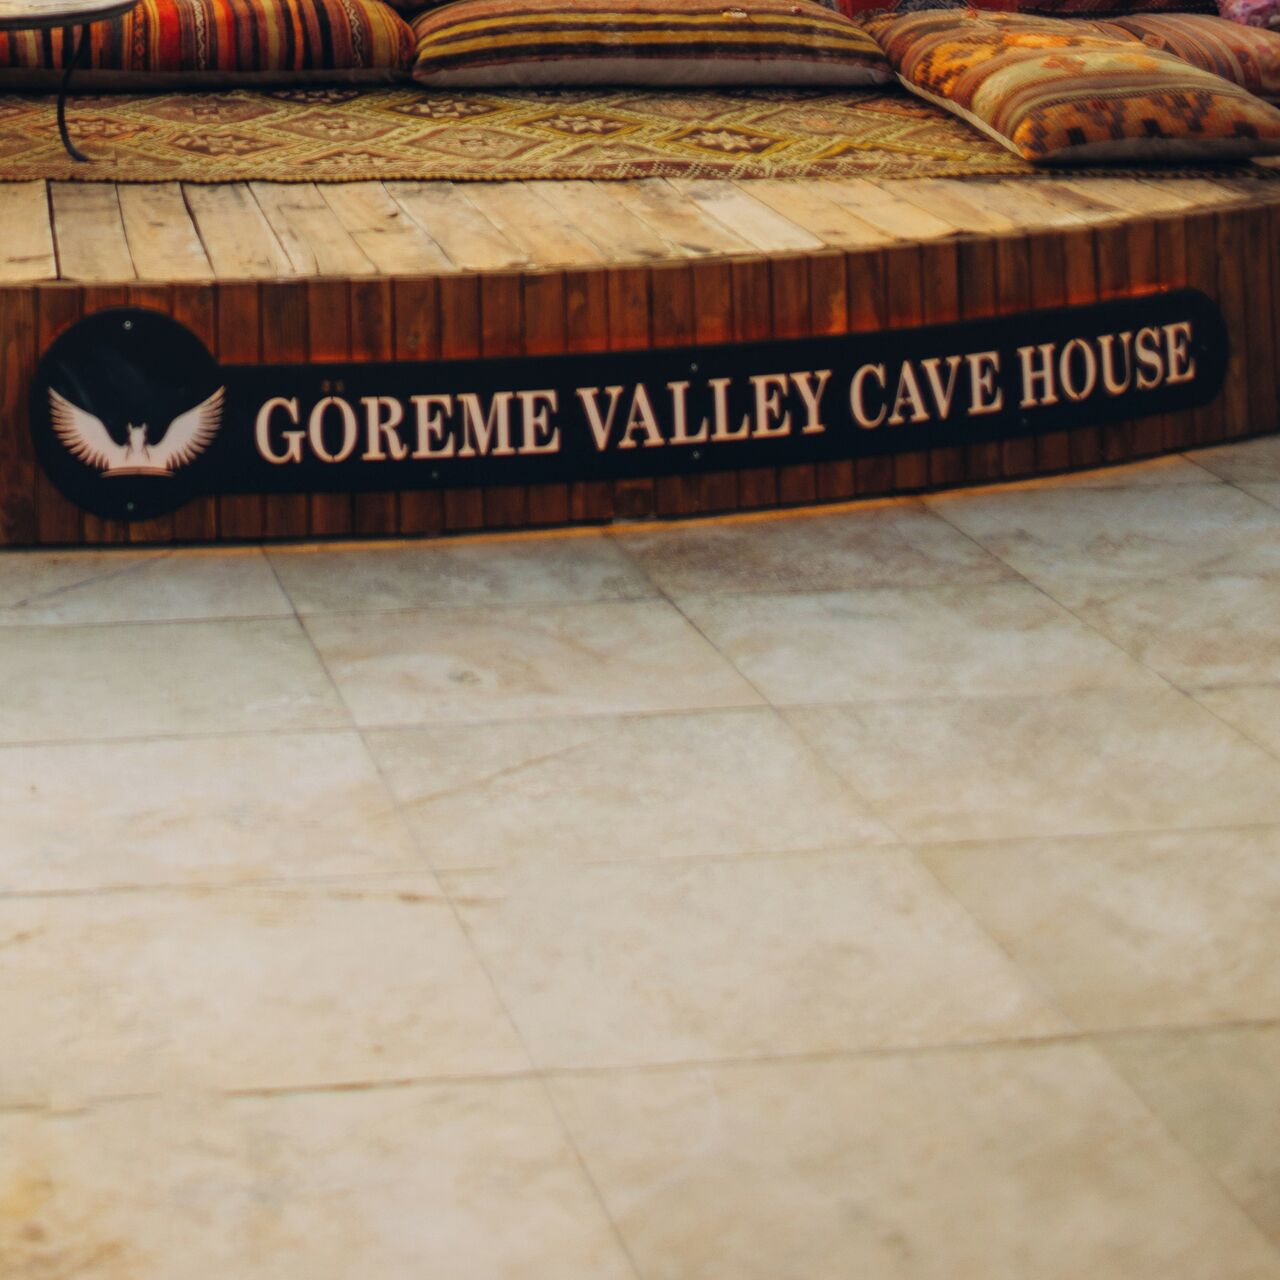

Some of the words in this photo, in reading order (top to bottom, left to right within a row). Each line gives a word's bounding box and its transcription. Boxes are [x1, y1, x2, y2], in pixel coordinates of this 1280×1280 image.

[576, 369, 831, 450] VALLEY
[850, 351, 1002, 429] CAVE
[1017, 321, 1197, 408] HOUSE
